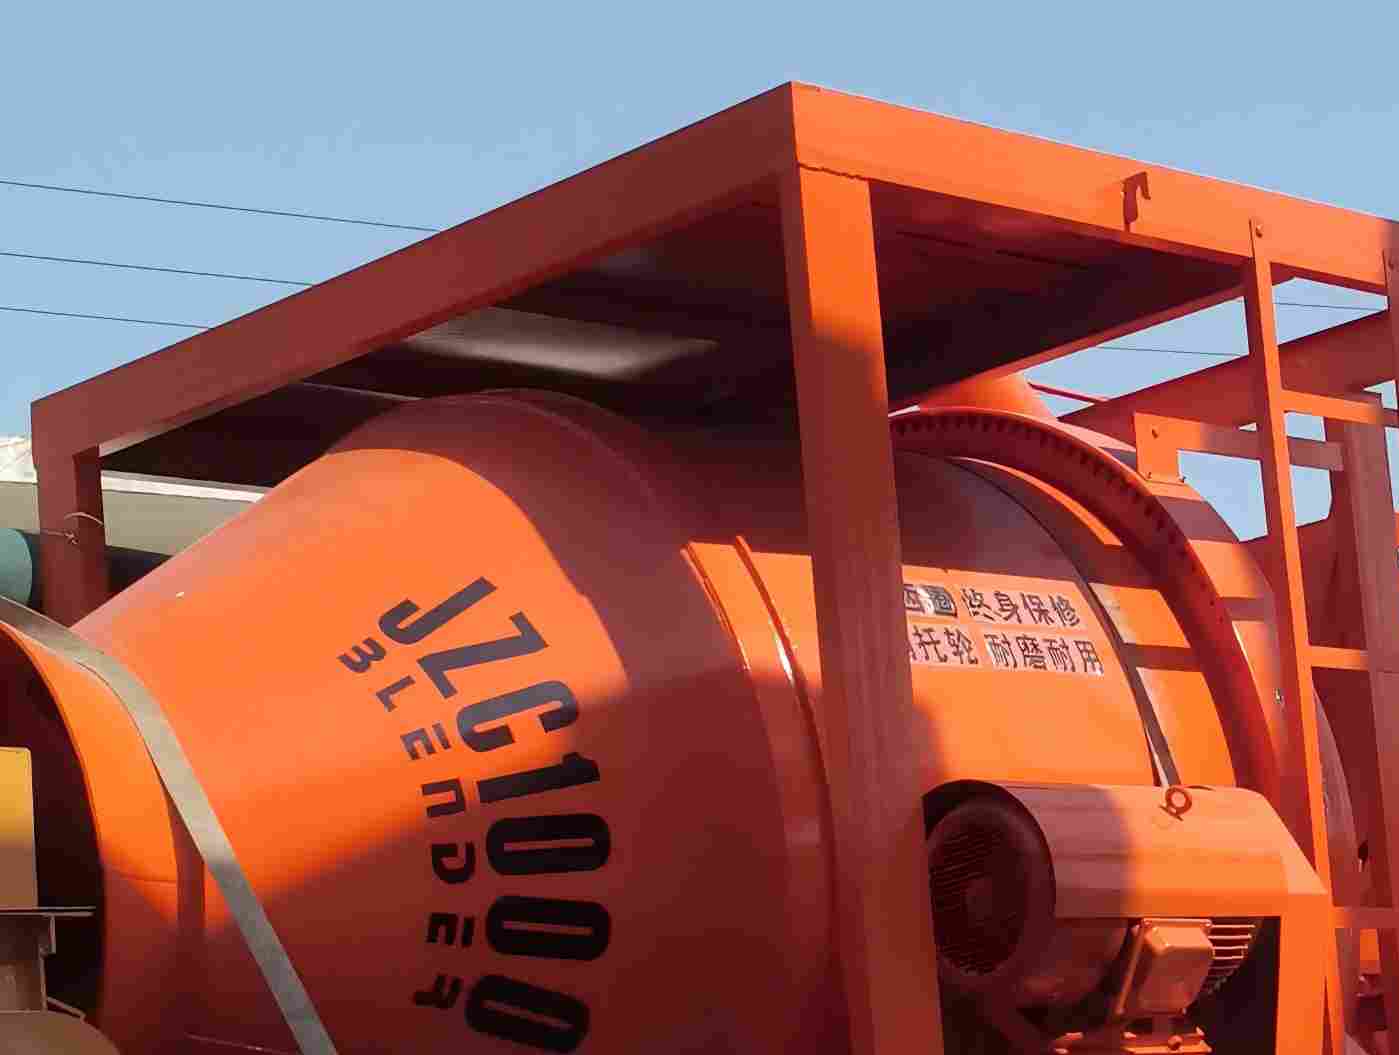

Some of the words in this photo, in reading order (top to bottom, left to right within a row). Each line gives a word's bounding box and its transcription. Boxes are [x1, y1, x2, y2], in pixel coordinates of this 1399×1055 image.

[909, 625, 979, 665] 托轮
[984, 632, 1104, 677] 耐磨耐用
[960, 586, 1081, 628] 终身保修
[338, 636, 476, 1012] BLENDER
[378, 575, 611, 1055] JZC1000
